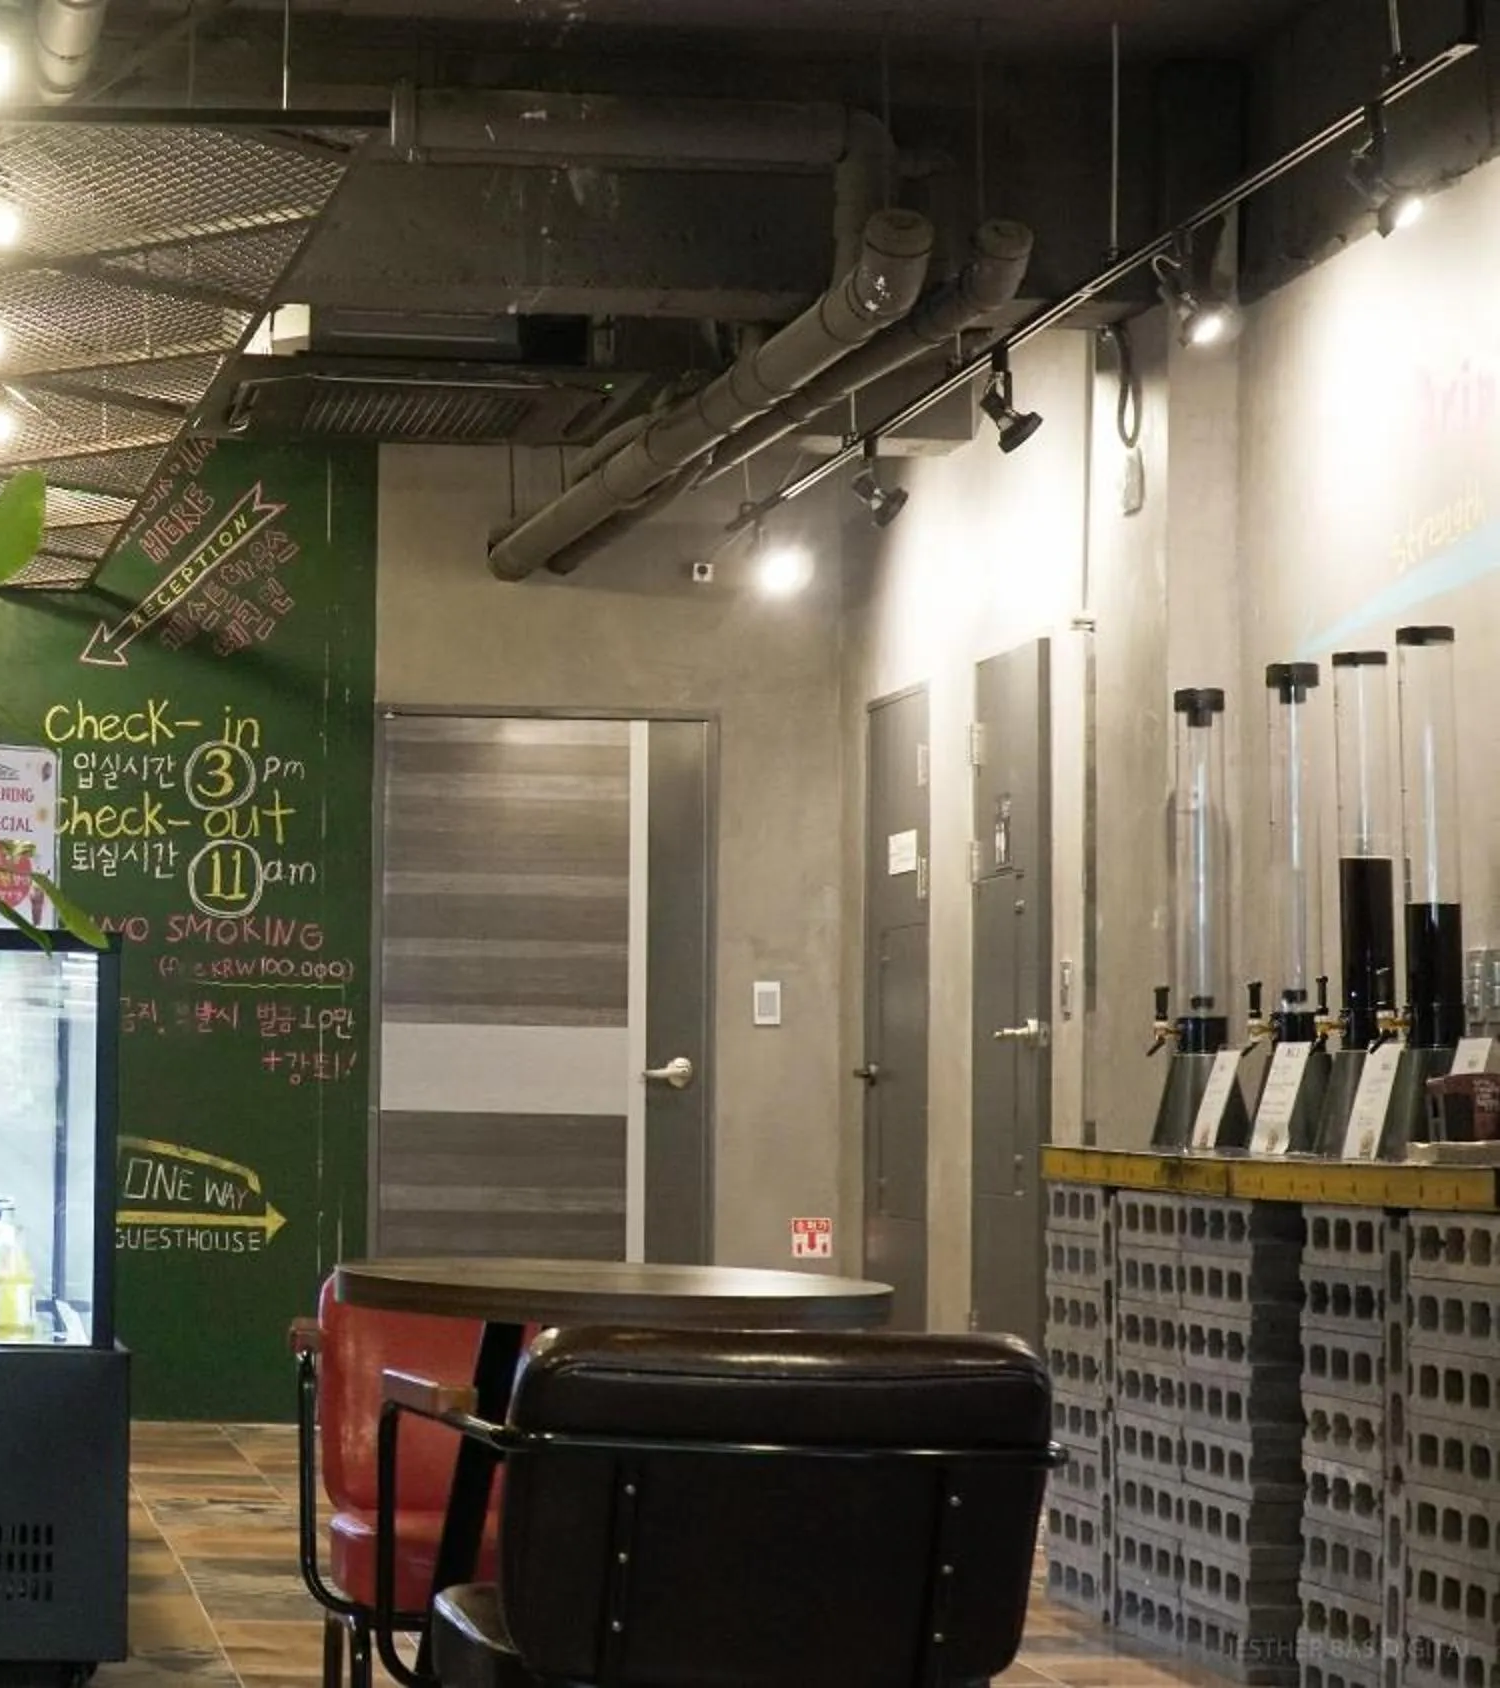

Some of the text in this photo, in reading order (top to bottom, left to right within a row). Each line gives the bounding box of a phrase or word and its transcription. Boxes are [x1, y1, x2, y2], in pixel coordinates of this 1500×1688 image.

[138, 481, 216, 564] HERE
[131, 512, 249, 632] RECEPTION
[72, 751, 177, 790] 입실시간
[196, 748, 235, 798] 3
[71, 840, 181, 879] 퇴실시간
[202, 850, 249, 901] 11
[262, 858, 316, 886] am
[166, 914, 325, 951] SMOKING
[123, 1156, 250, 1212] ONE WAY
[115, 1226, 262, 1253] GUESTHOUSE
